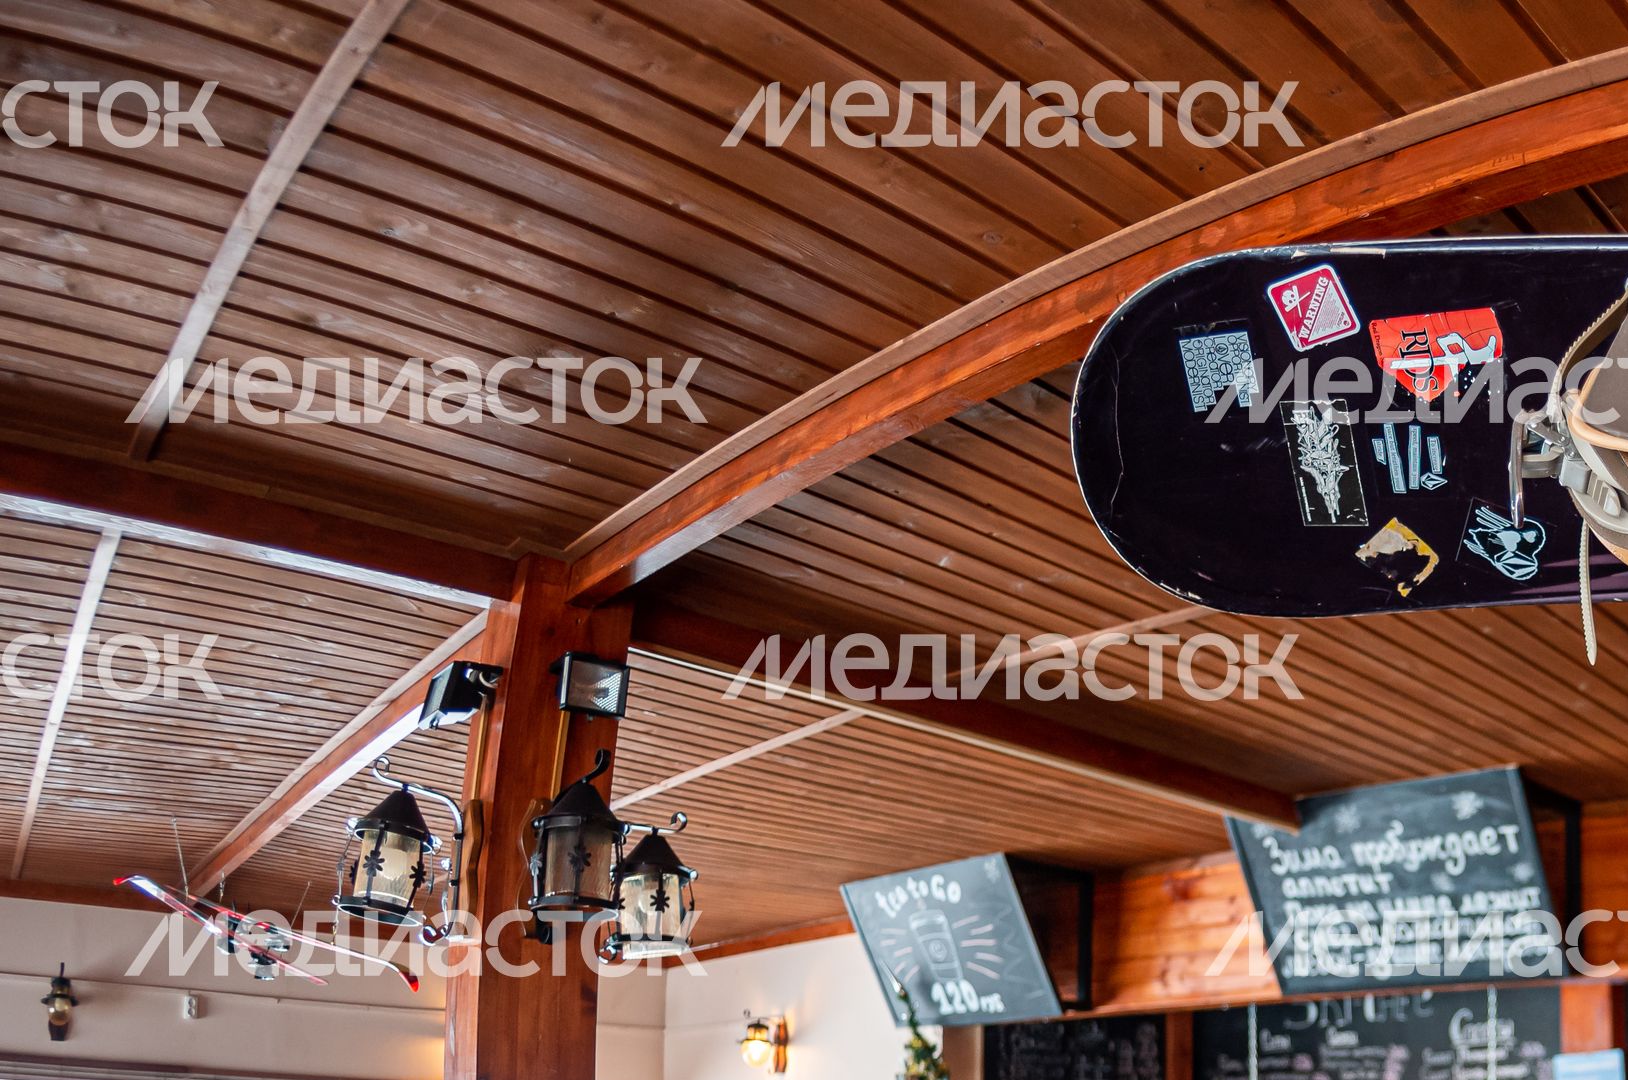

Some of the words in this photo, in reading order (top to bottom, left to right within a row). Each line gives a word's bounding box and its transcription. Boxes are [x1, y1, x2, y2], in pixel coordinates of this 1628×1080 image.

[1297, 276, 1329, 338] WARNING
[1399, 328, 1439, 392] RDS
[1262, 836, 1345, 876] Зима
